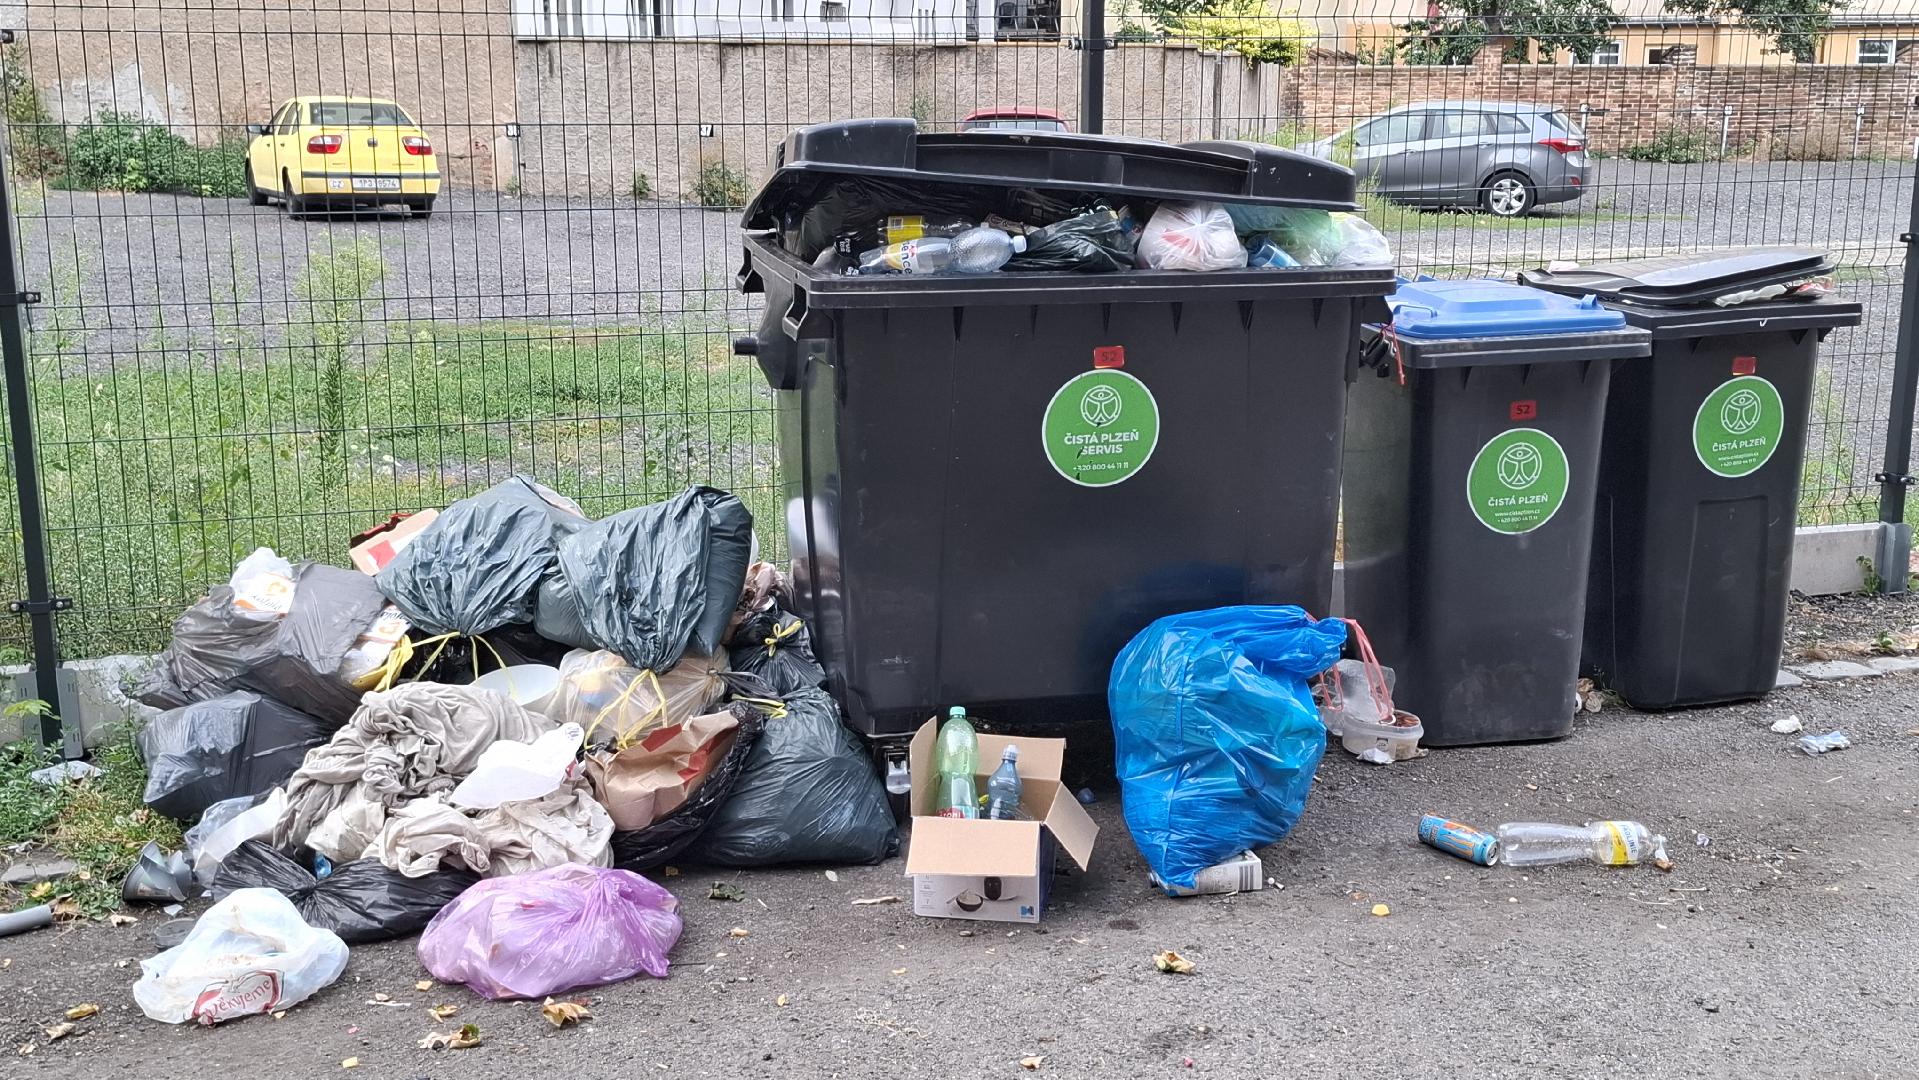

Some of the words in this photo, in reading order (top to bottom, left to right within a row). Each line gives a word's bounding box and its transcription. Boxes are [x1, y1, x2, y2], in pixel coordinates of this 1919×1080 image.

[1064, 432, 1098, 445] ČISTÁ
[1101, 428, 1139, 443] PLZEŇ
[1712, 440, 1738, 452] ČISTÁ
[1740, 435, 1766, 448] PLZEŇ
[1081, 444, 1123, 456] SERVIS
[1488, 495, 1516, 507] ČISTÁ
[1518, 492, 1549, 505] PLZEŇ
